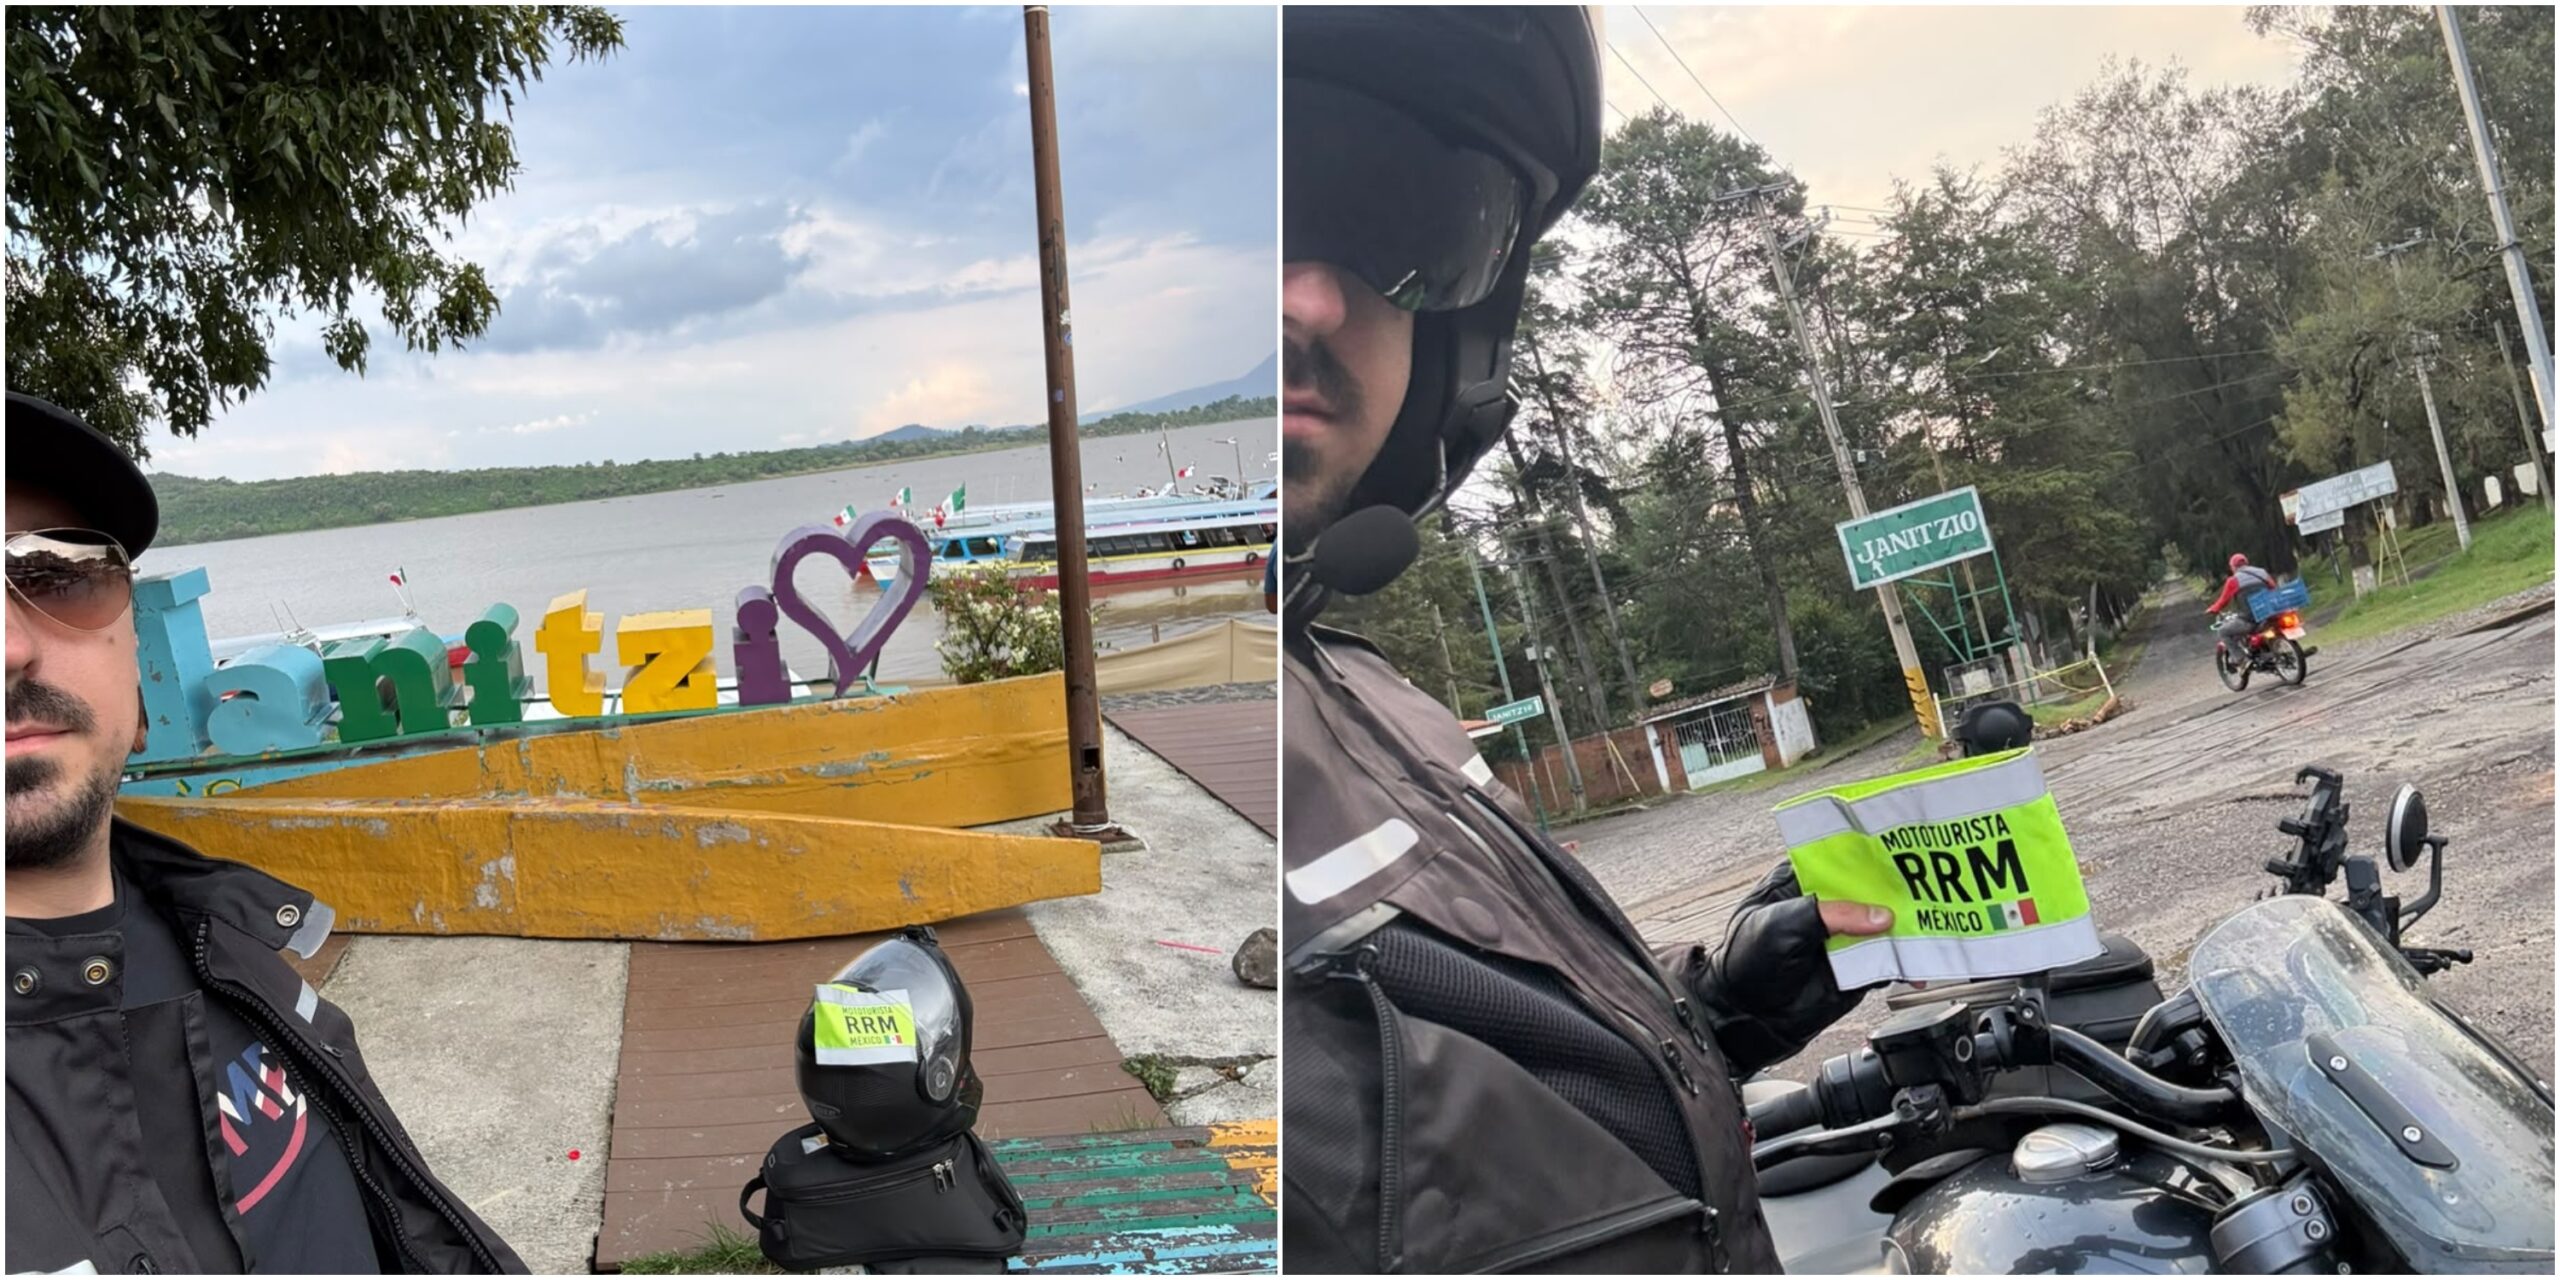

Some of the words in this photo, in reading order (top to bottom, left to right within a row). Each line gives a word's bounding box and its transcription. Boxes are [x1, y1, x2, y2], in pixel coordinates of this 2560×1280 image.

[1856, 510, 1977, 564] JANITZIO
[1880, 813, 2011, 851] MOTOTURISTA
[1892, 839, 2029, 904] RRM
[1916, 905, 1983, 932] MÉXICO
[842, 1006, 893, 1016] MOTOTURISTA
[845, 1015, 899, 1034] RRM
